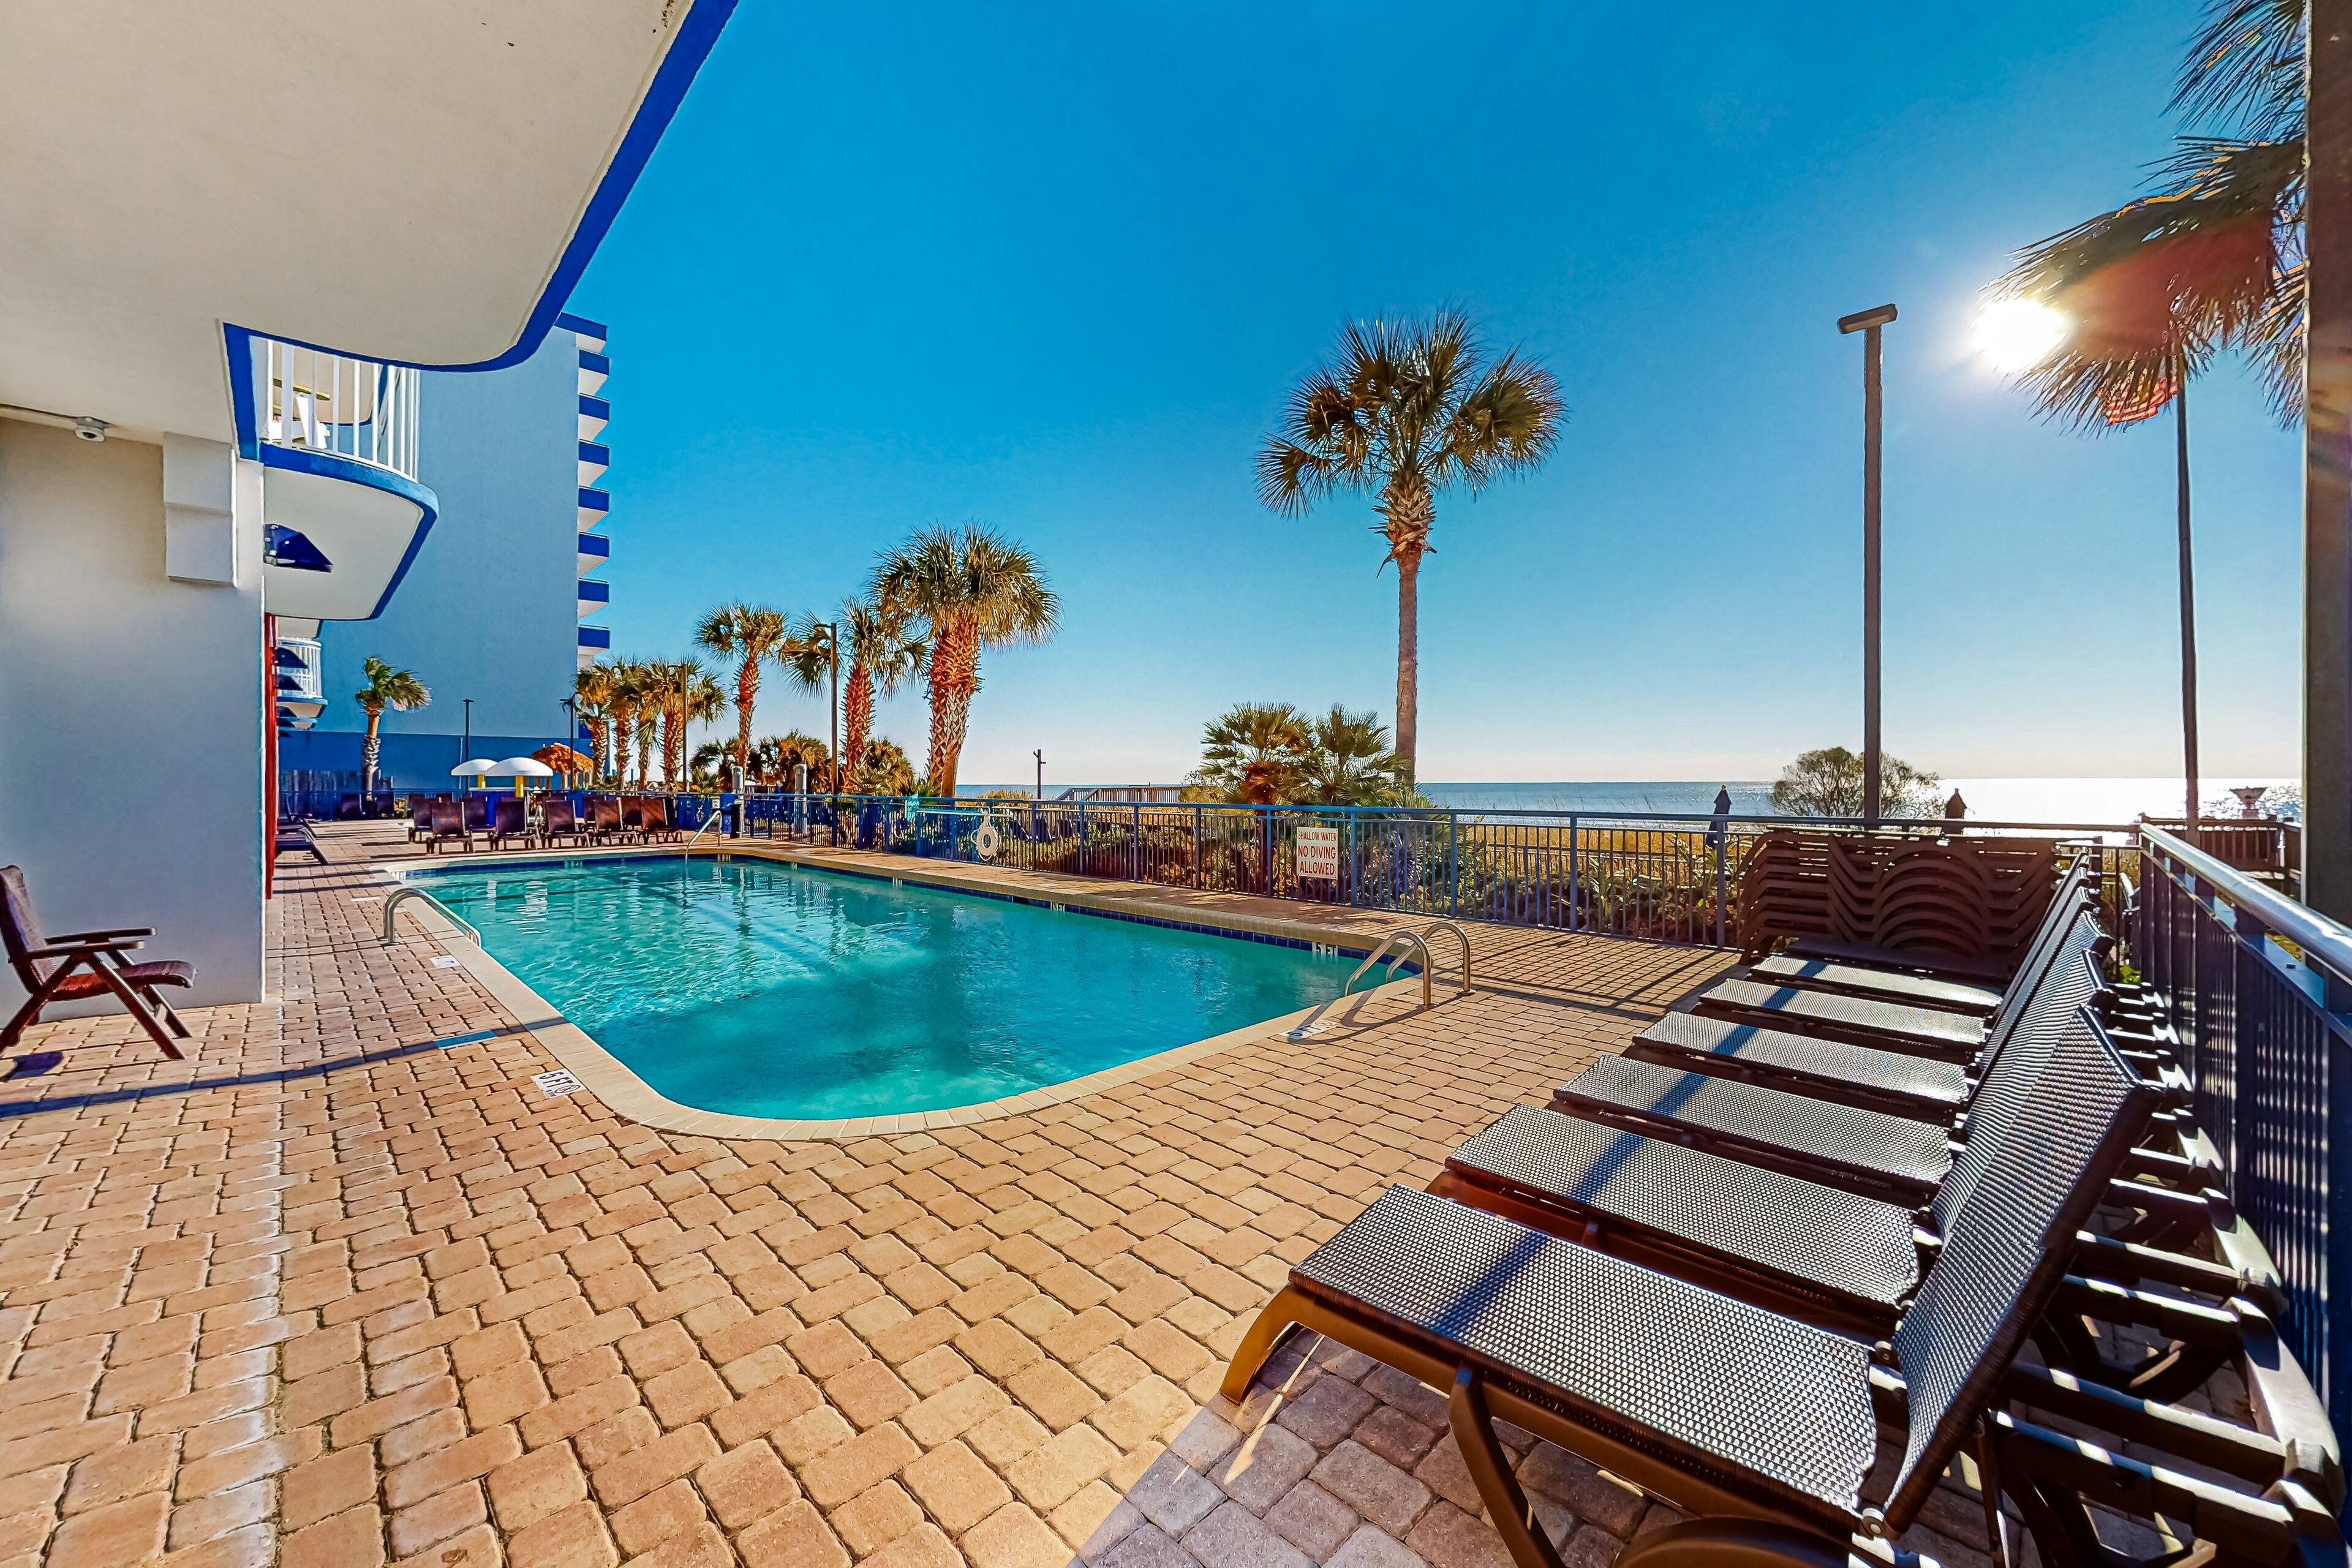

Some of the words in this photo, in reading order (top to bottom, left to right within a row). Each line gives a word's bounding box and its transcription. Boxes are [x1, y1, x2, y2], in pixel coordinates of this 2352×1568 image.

[1321, 832, 1337, 842] WATER
[1298, 845, 1308, 858] NO
[1311, 846, 1336, 859] DIVING
[1299, 861, 1335, 875] ALLOWED
[1316, 941, 1322, 954] 5
[1325, 944, 1337, 956] FT
[1297, 1025, 1322, 1033] FT
[538, 1071, 565, 1080] 5
[543, 1077, 574, 1088] FT
